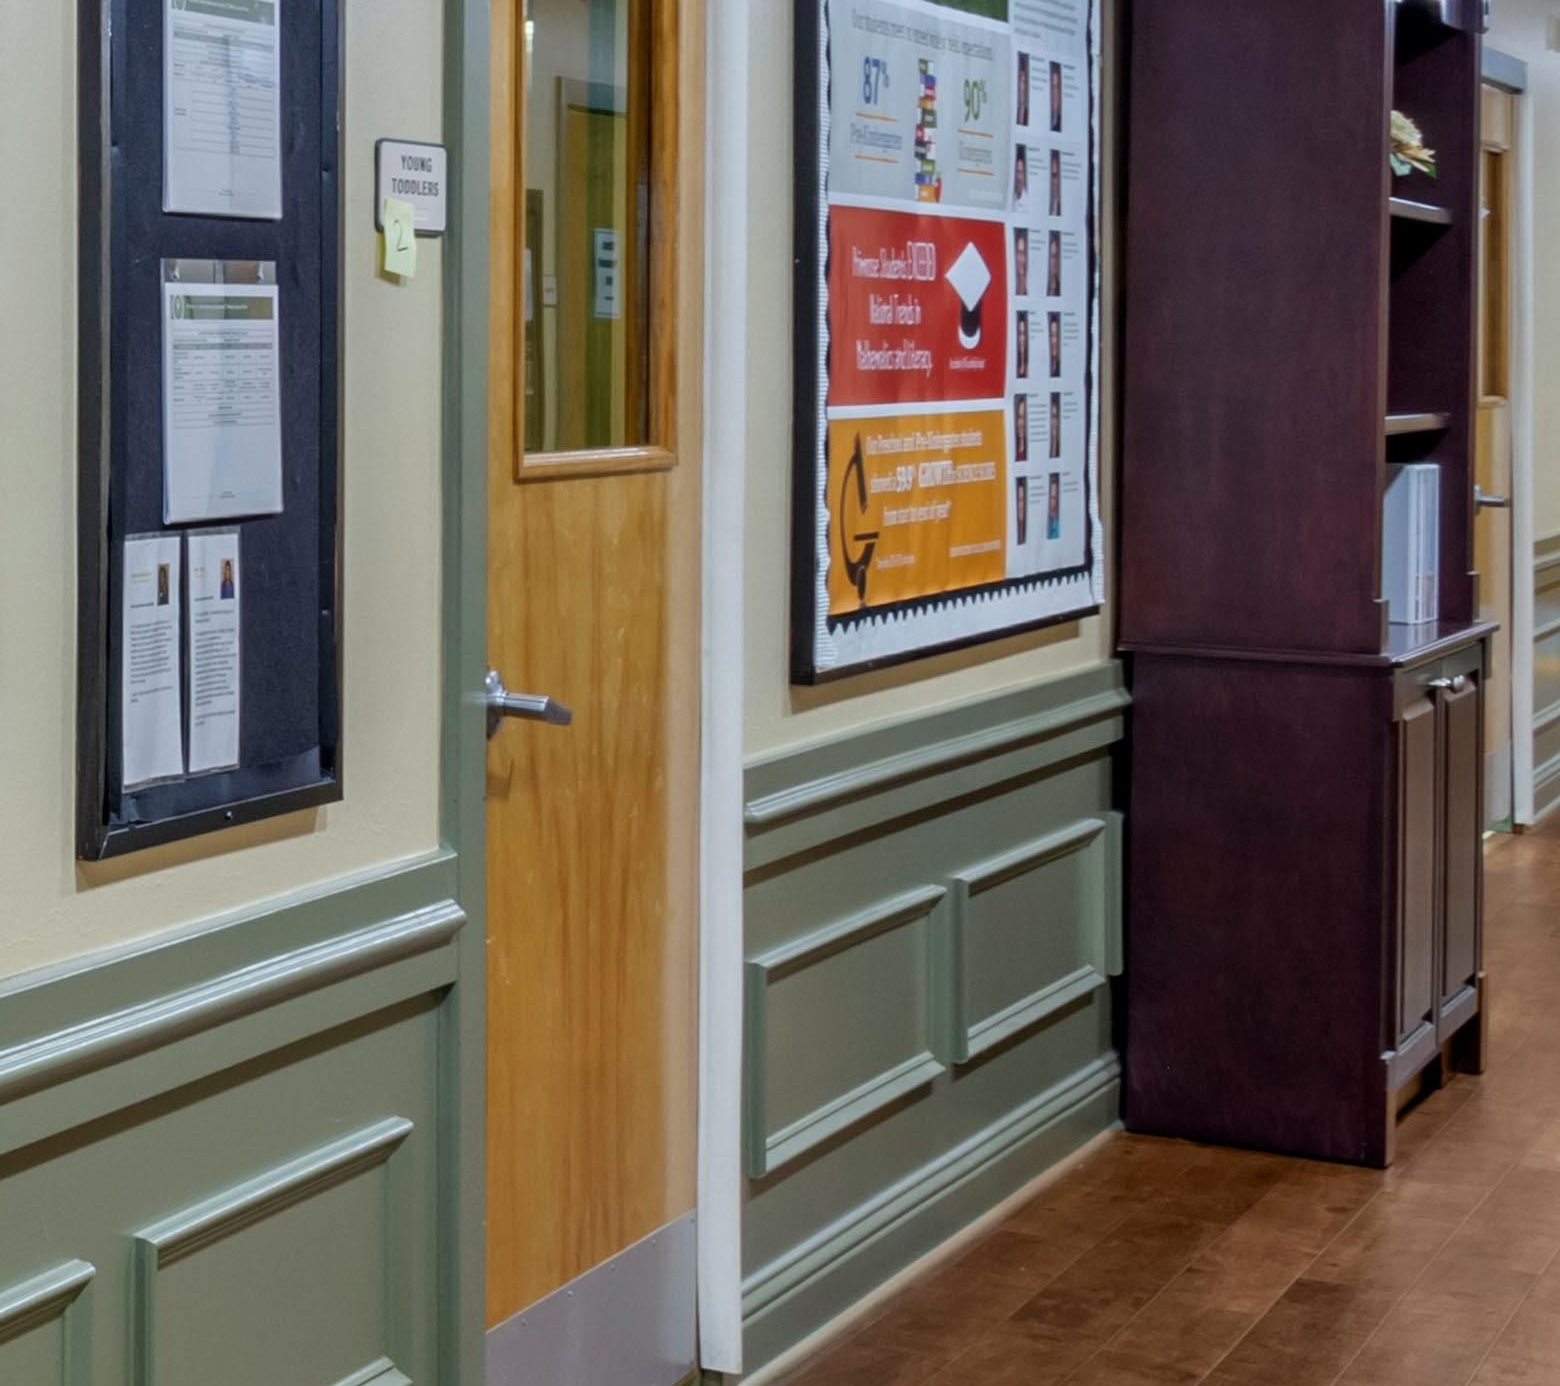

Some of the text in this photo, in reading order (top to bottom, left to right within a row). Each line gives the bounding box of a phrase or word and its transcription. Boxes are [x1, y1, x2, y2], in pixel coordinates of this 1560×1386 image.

[863, 56, 890, 105] 87%
[964, 79, 988, 123] 90%
[401, 155, 432, 173] YOUNG
[392, 178, 439, 197] TODDLERS
[393, 219, 408, 252] 2
